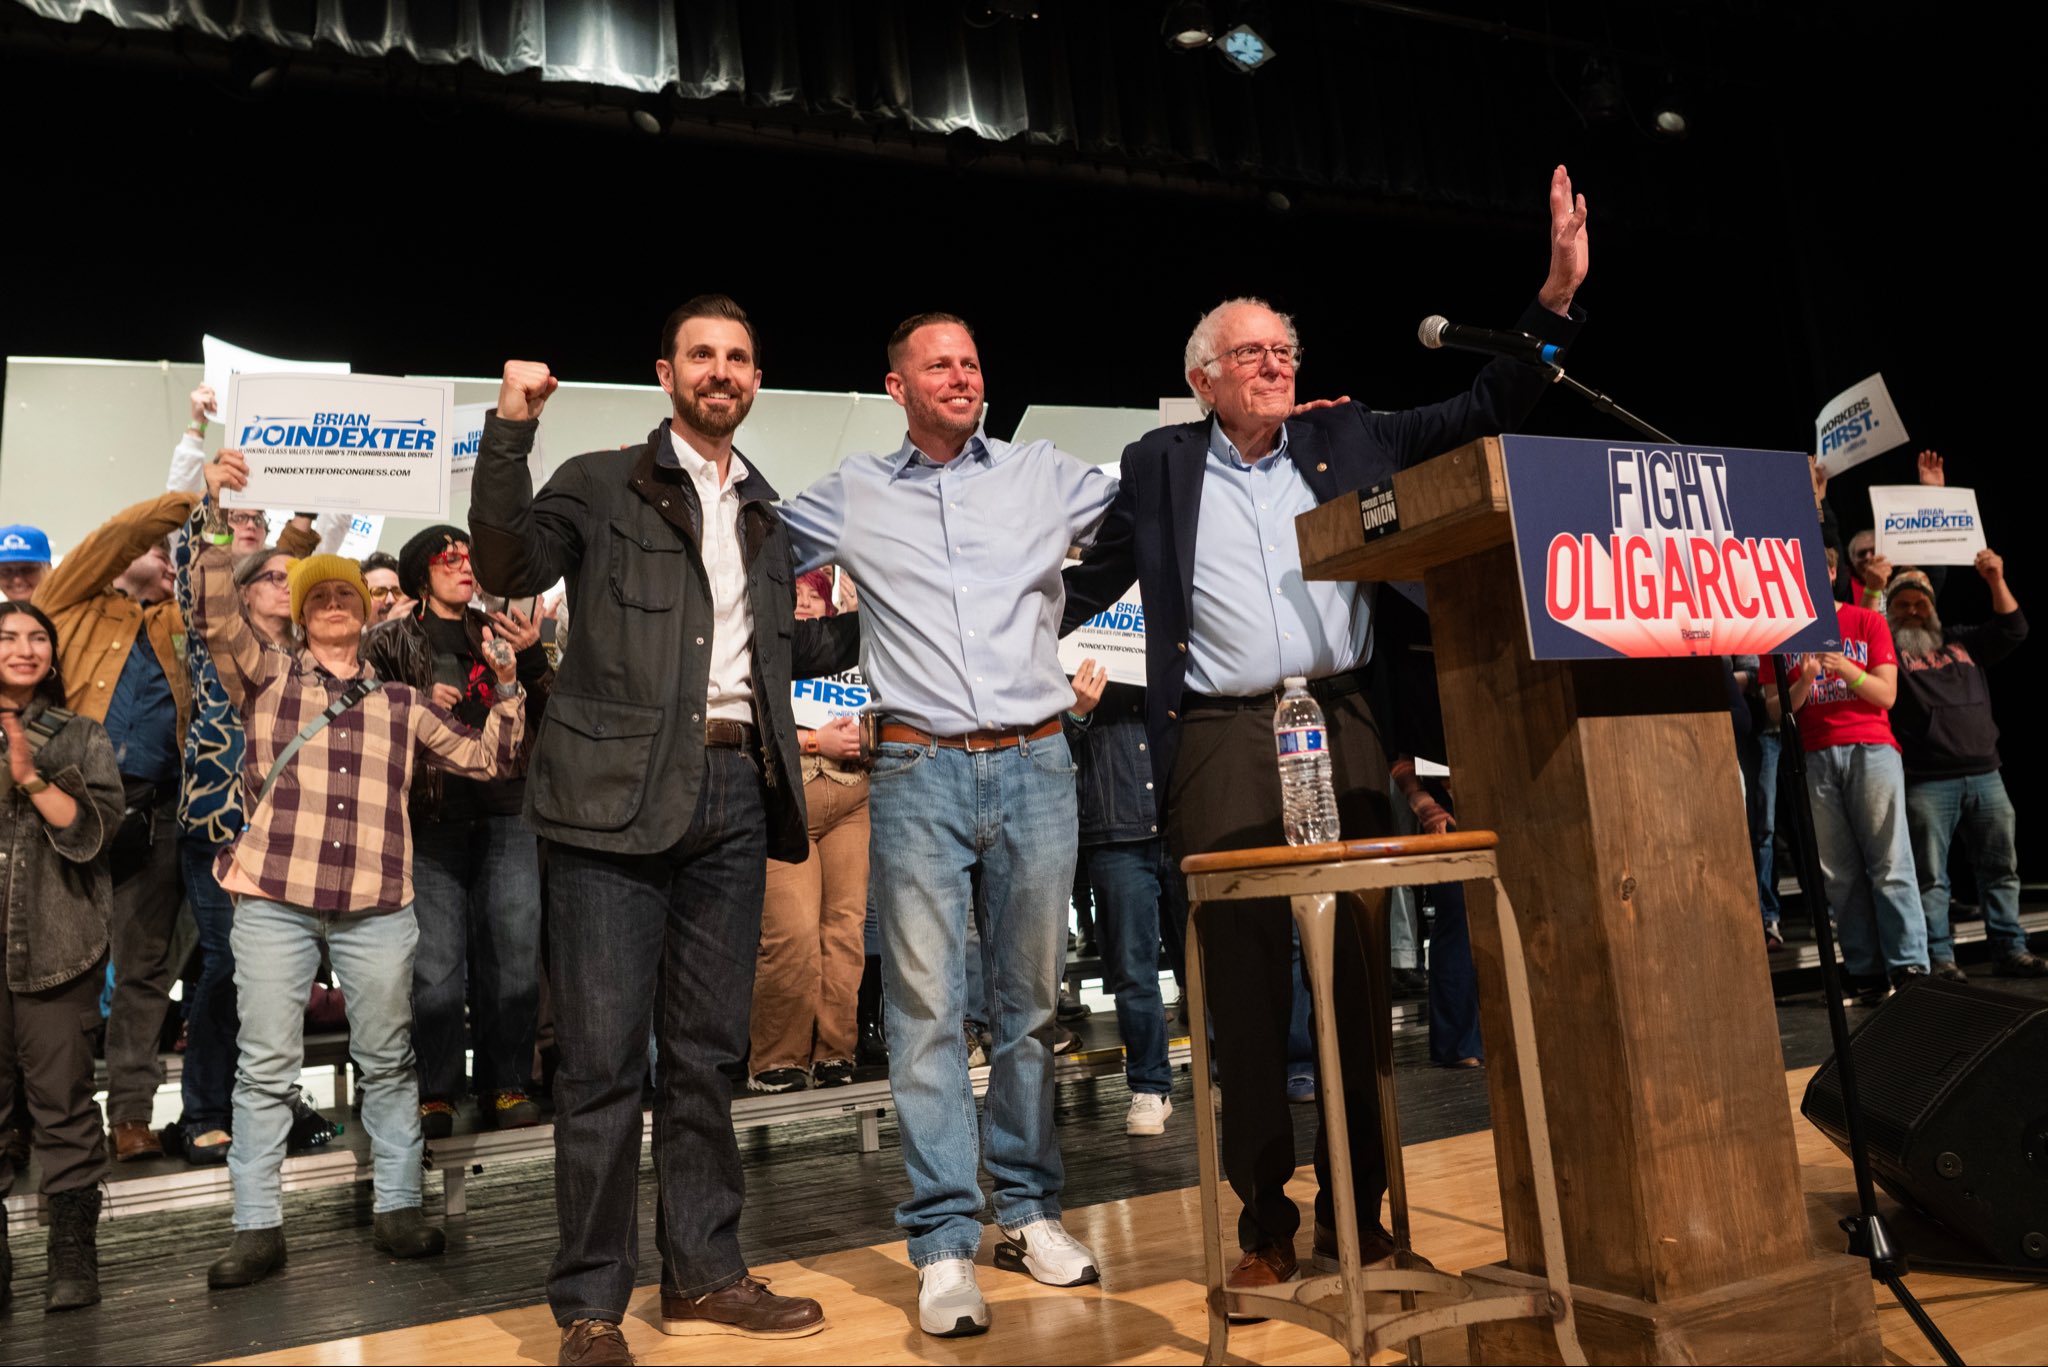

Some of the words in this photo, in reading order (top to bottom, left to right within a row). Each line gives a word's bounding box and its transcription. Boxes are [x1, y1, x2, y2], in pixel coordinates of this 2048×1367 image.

[313, 412, 371, 426] BRIAN
[1821, 397, 1870, 437] WORKERS
[240, 425, 437, 450] POINDEXTER
[1822, 409, 1879, 456] FIRST.
[264, 466, 411, 477] POINDEXTERFORCONGRESS.COM
[1608, 448, 1734, 531] FIGHT
[1363, 501, 1397, 530] UNION
[1885, 515, 1974, 530] POINDEXTER
[1545, 532, 1818, 621] OLIGARCHY
[1116, 602, 1144, 614] BRIA
[1681, 629, 1710, 640] Bernie
[794, 680, 871, 707] FIRS
